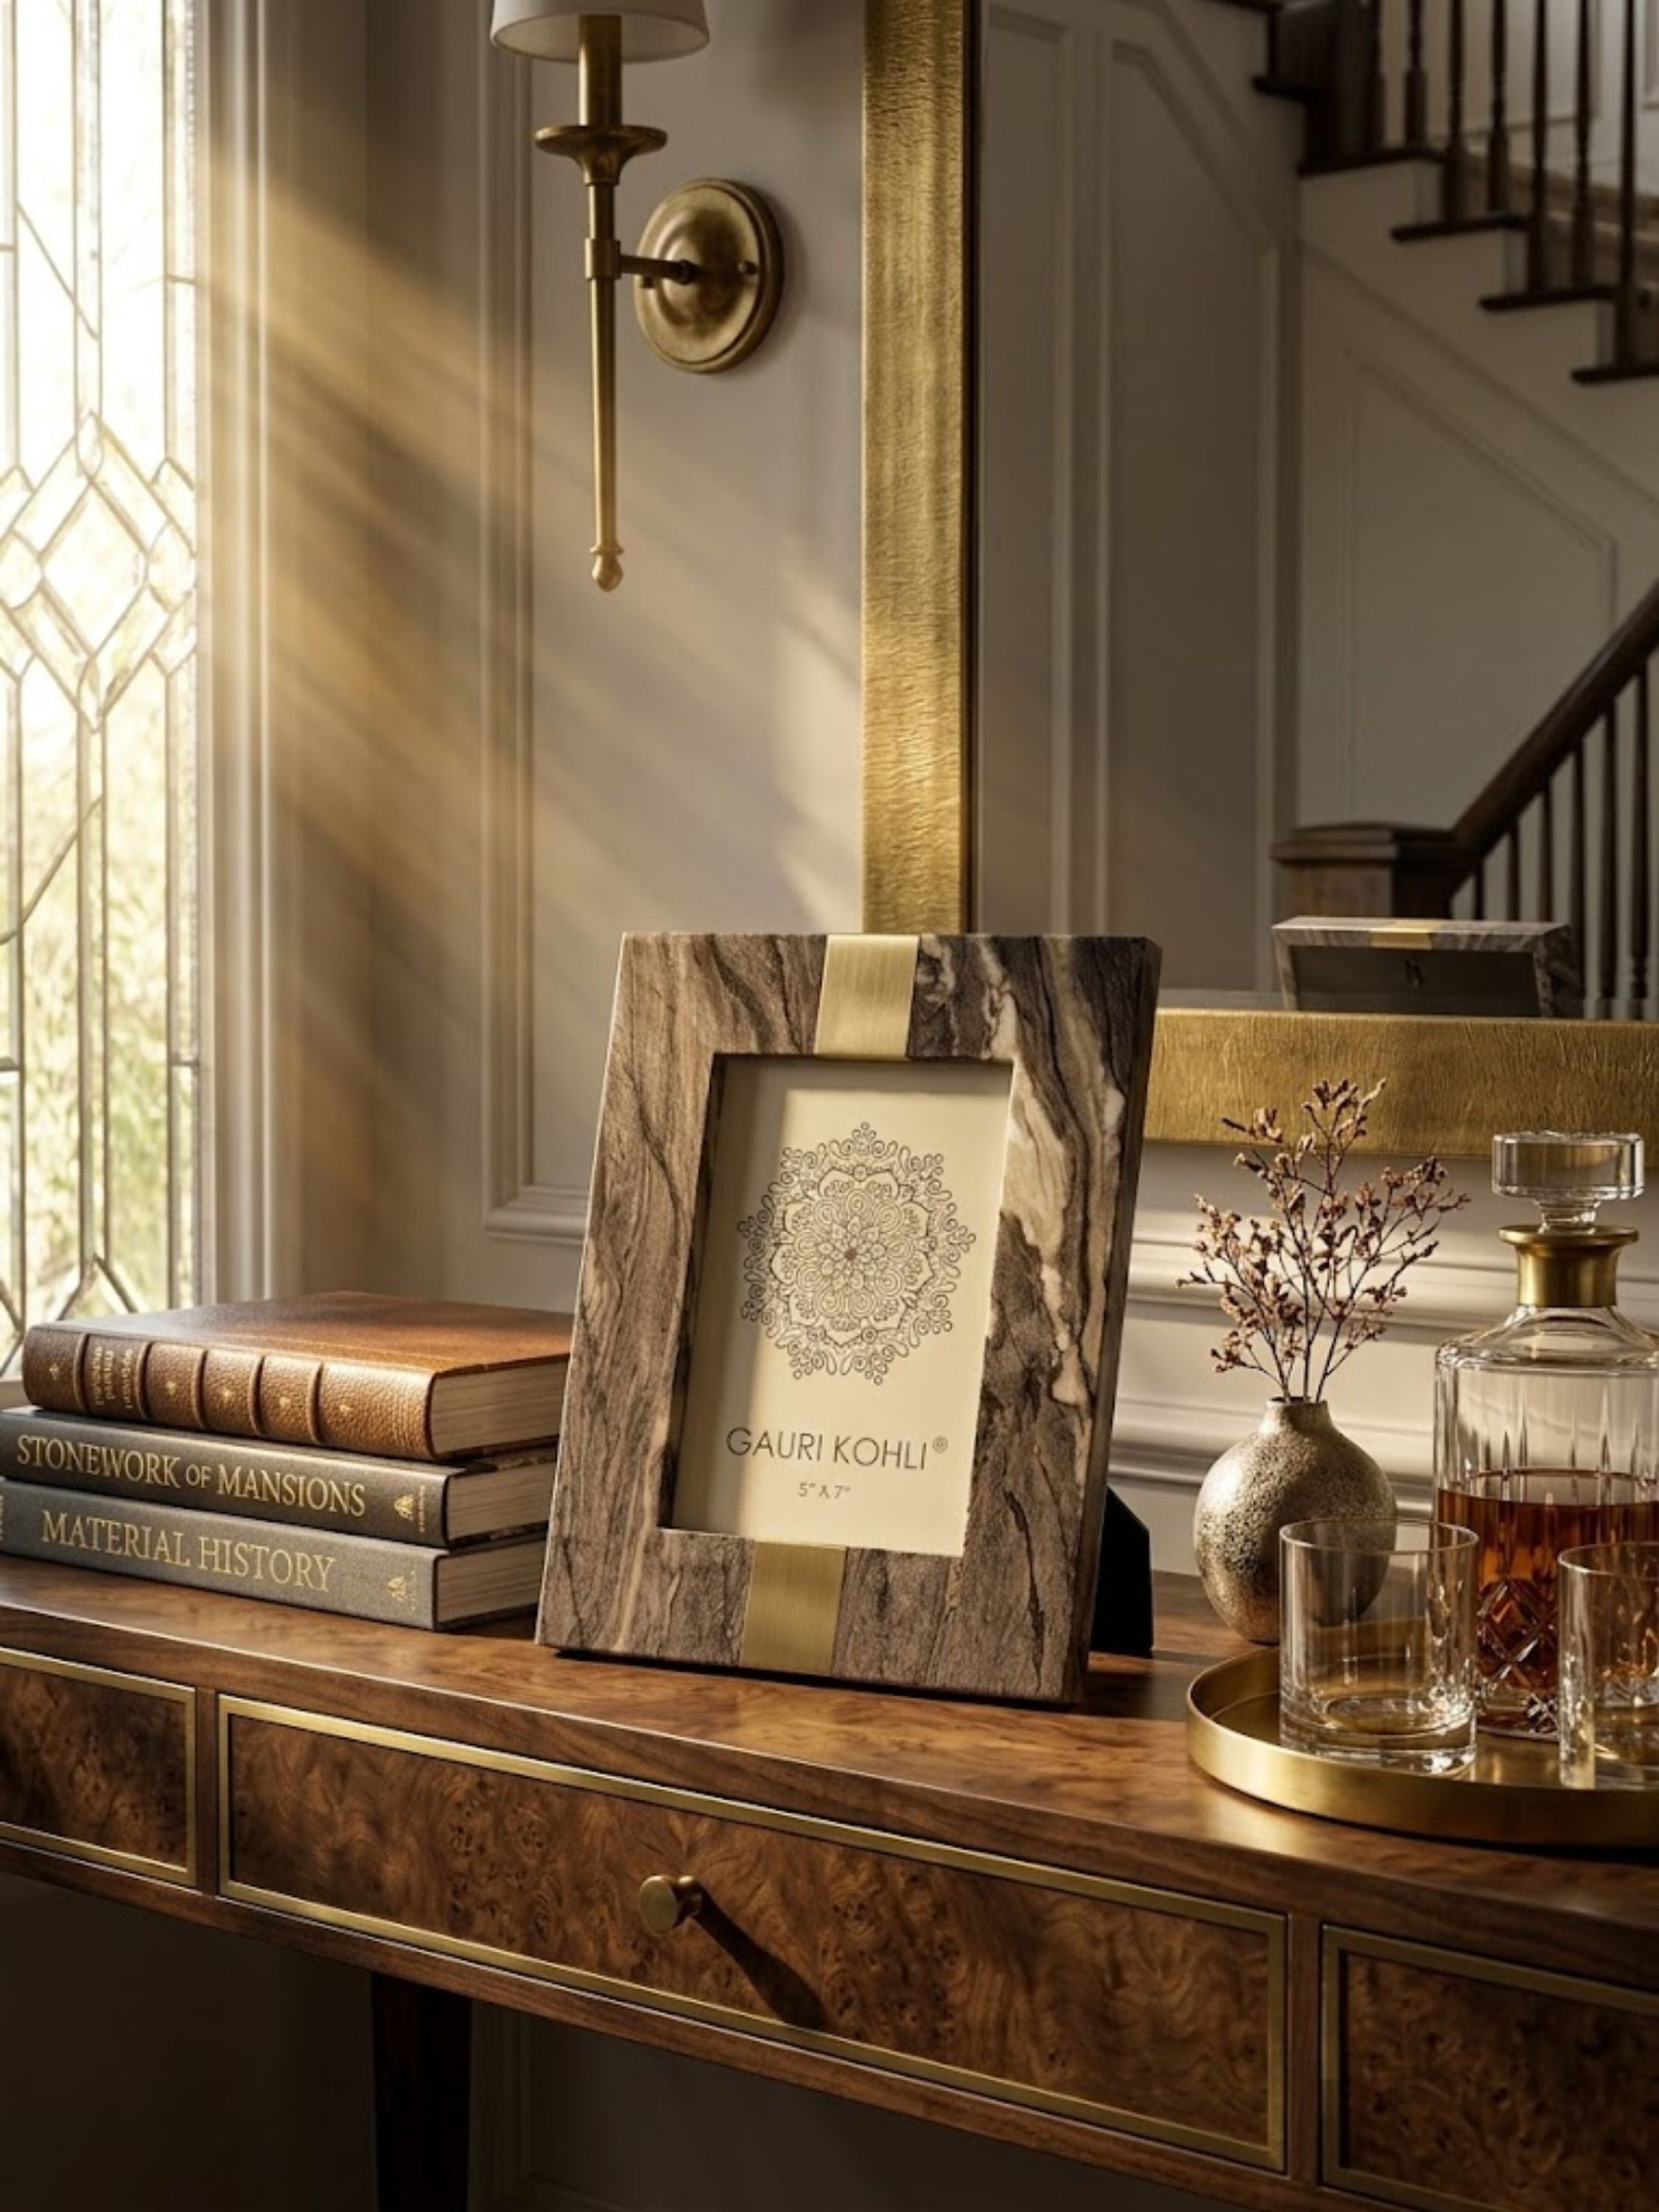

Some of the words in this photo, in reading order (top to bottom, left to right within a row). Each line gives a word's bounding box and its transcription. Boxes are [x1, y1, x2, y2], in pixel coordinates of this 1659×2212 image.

[17, 1434, 181, 1488] STONEWORK
[217, 1464, 366, 1517] MANSIONS
[726, 1427, 823, 1462] GAURI
[41, 1509, 190, 1567] MATERIAL
[198, 1536, 337, 1593] HISTORY
